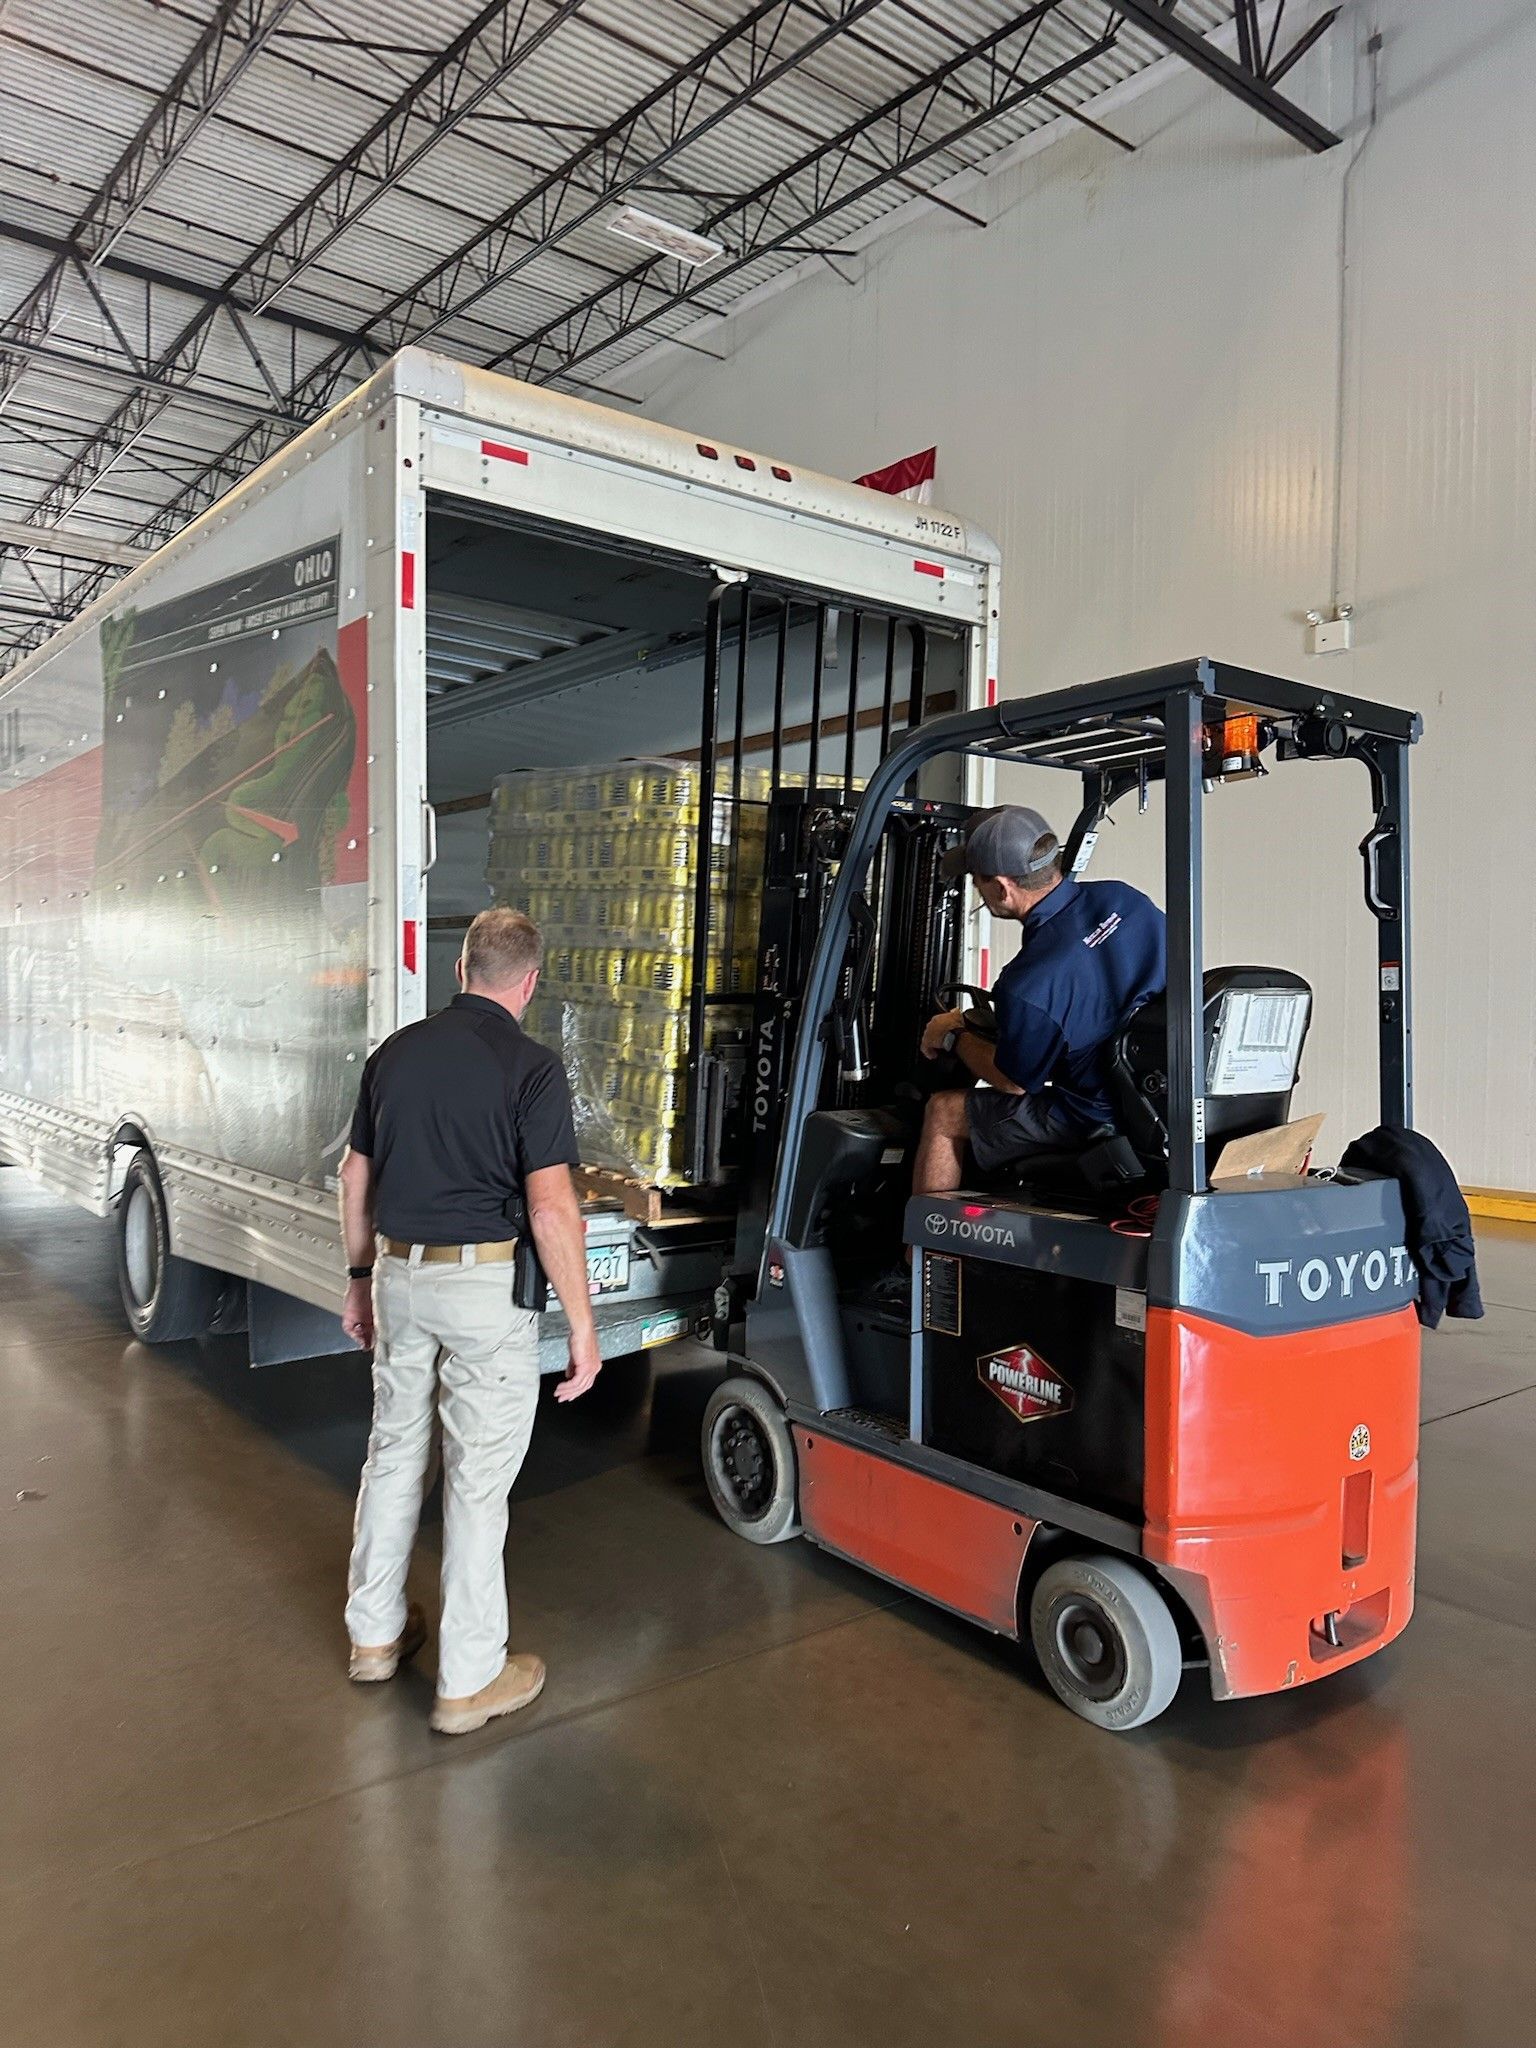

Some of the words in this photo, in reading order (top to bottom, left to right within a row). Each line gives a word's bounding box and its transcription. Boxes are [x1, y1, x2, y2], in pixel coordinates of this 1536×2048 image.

[915, 516, 928, 531] JH
[930, 521, 953, 537] 1722
[954, 527, 961, 539] F
[294, 550, 332, 587] OHIO
[752, 1015, 777, 1133] TOYOTA
[950, 1219, 1015, 1248] TOYOTA
[586, 1256, 621, 1281] 237
[988, 1361, 1062, 1405] POWERLINE
